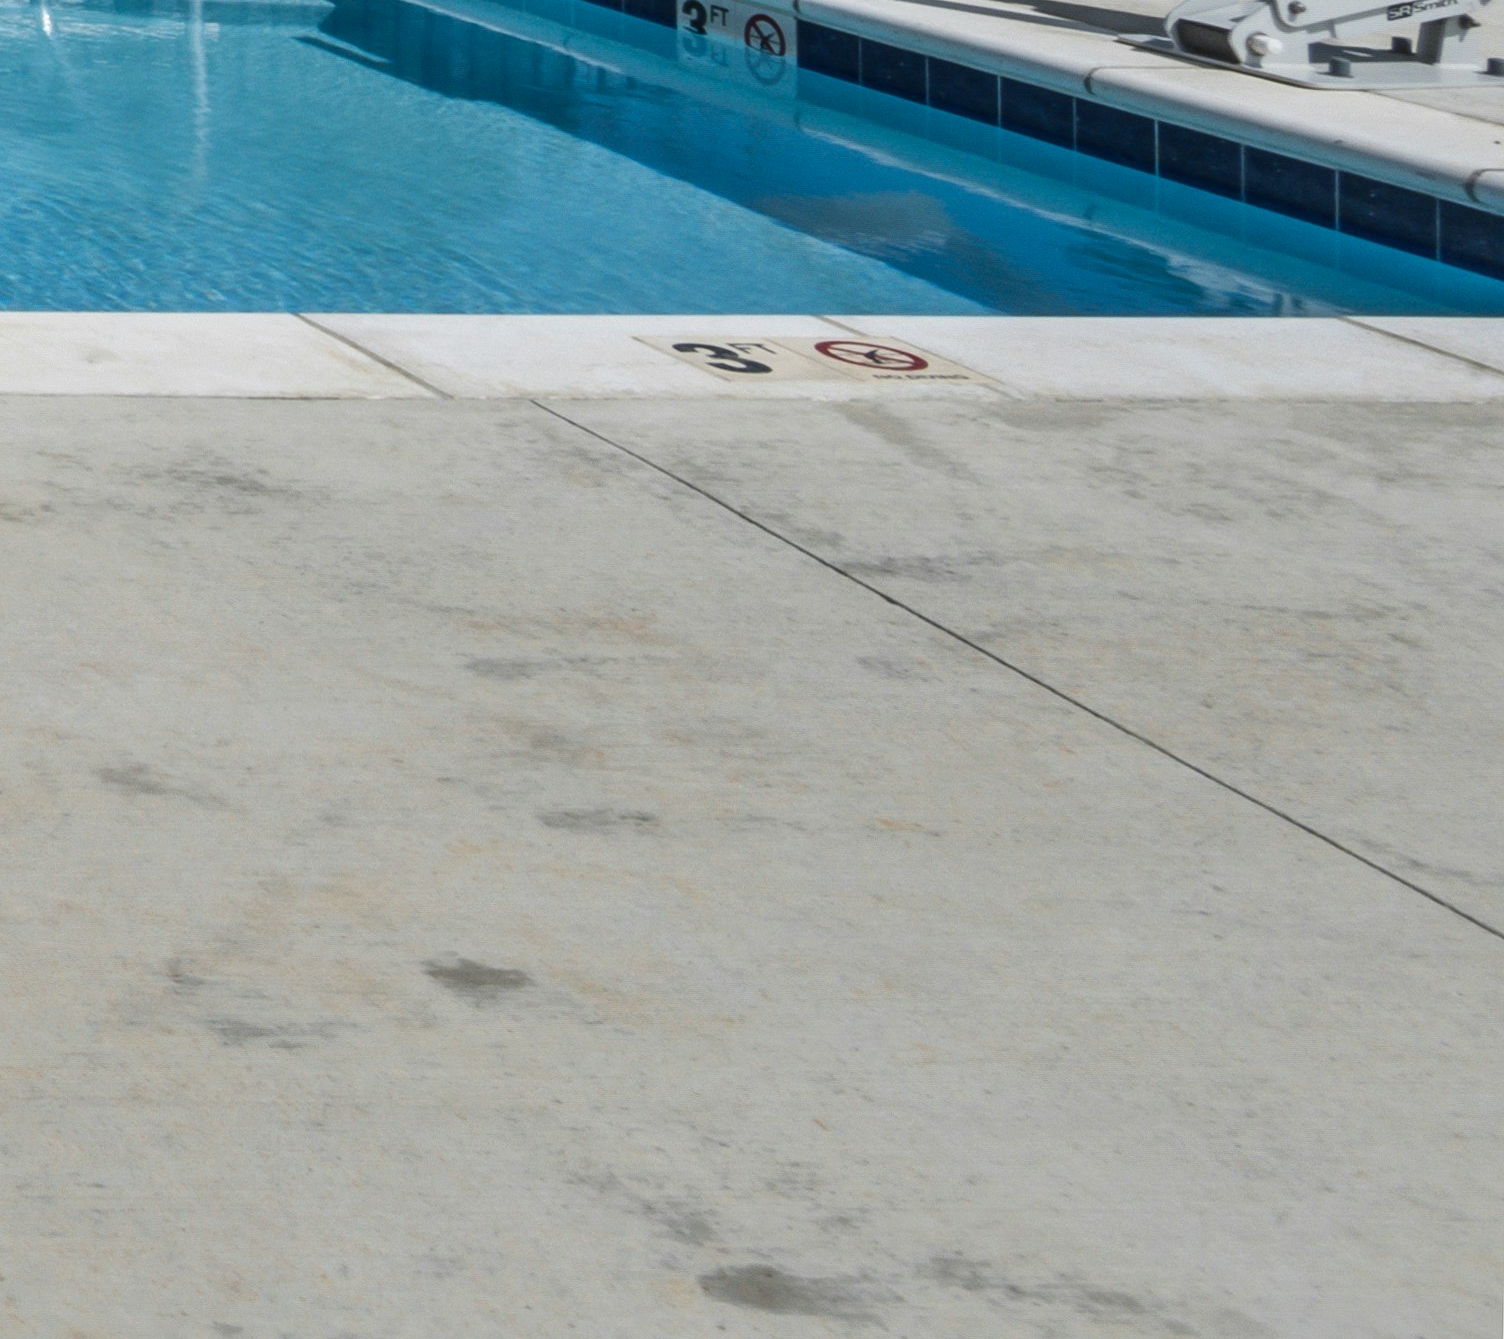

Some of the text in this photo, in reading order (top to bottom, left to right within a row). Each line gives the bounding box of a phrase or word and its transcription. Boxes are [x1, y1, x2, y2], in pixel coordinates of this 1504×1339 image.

[710, 4, 729, 26] FT
[672, 342, 777, 374] 3 FT
